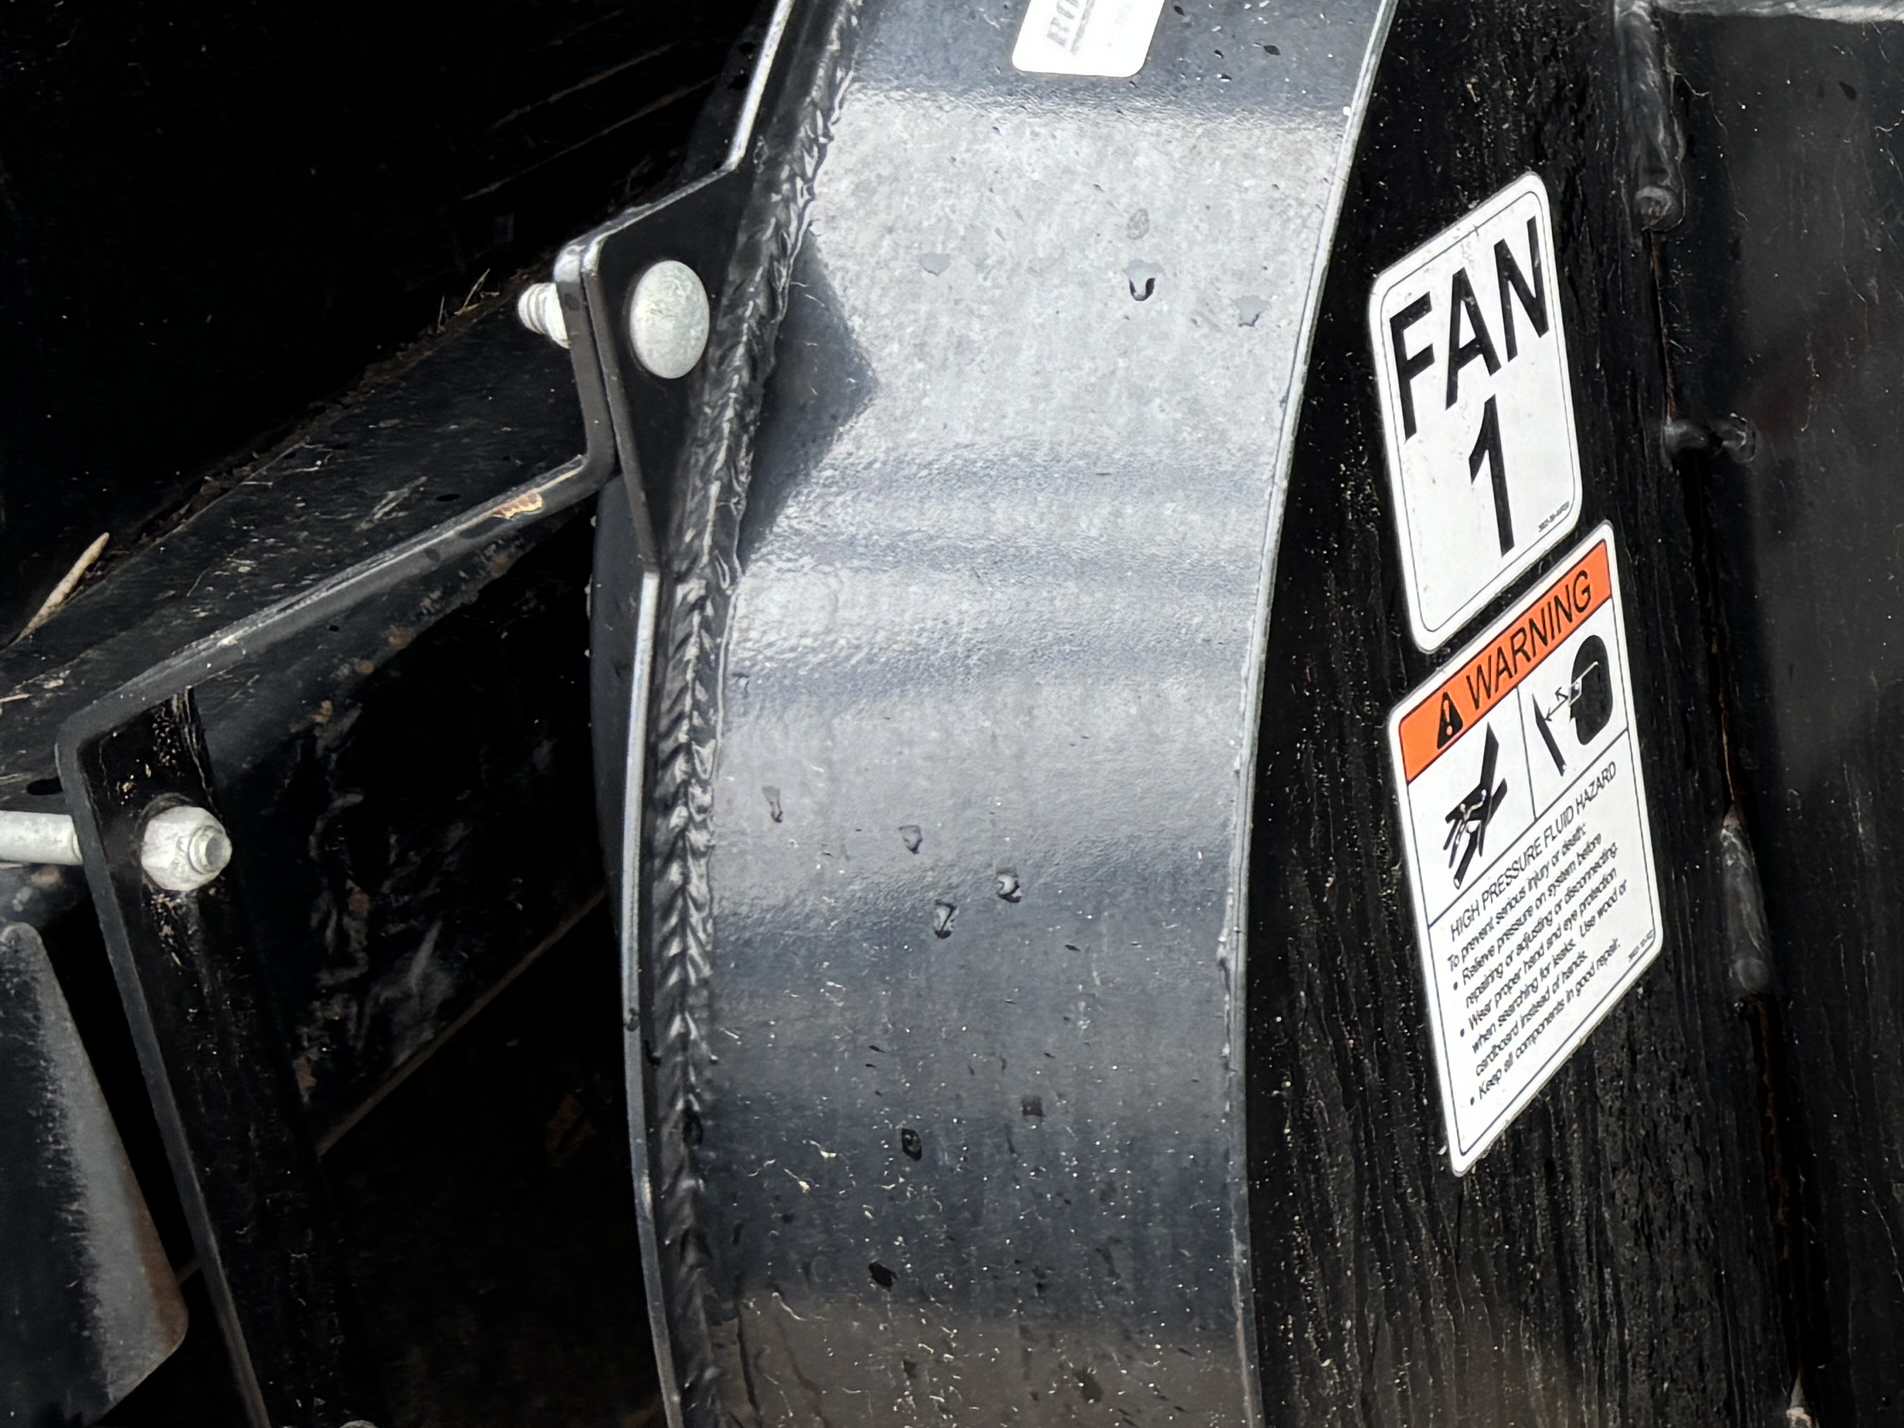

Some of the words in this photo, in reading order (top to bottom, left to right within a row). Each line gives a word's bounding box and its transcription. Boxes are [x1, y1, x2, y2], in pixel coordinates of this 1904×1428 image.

[1389, 215, 1550, 445] FAN
[1468, 393, 1516, 559] 1
[1467, 568, 1592, 713] WARNING
[1450, 899, 1480, 941] HIGH
[1480, 836, 1542, 910] PRESSURE
[1543, 804, 1574, 848] FLUID
[1574, 760, 1616, 815] HAZARD
[1468, 998, 1492, 1030] Wear
[1493, 967, 1521, 1008] proper
[1522, 942, 1544, 974] hand
[1578, 867, 1616, 916] protection
